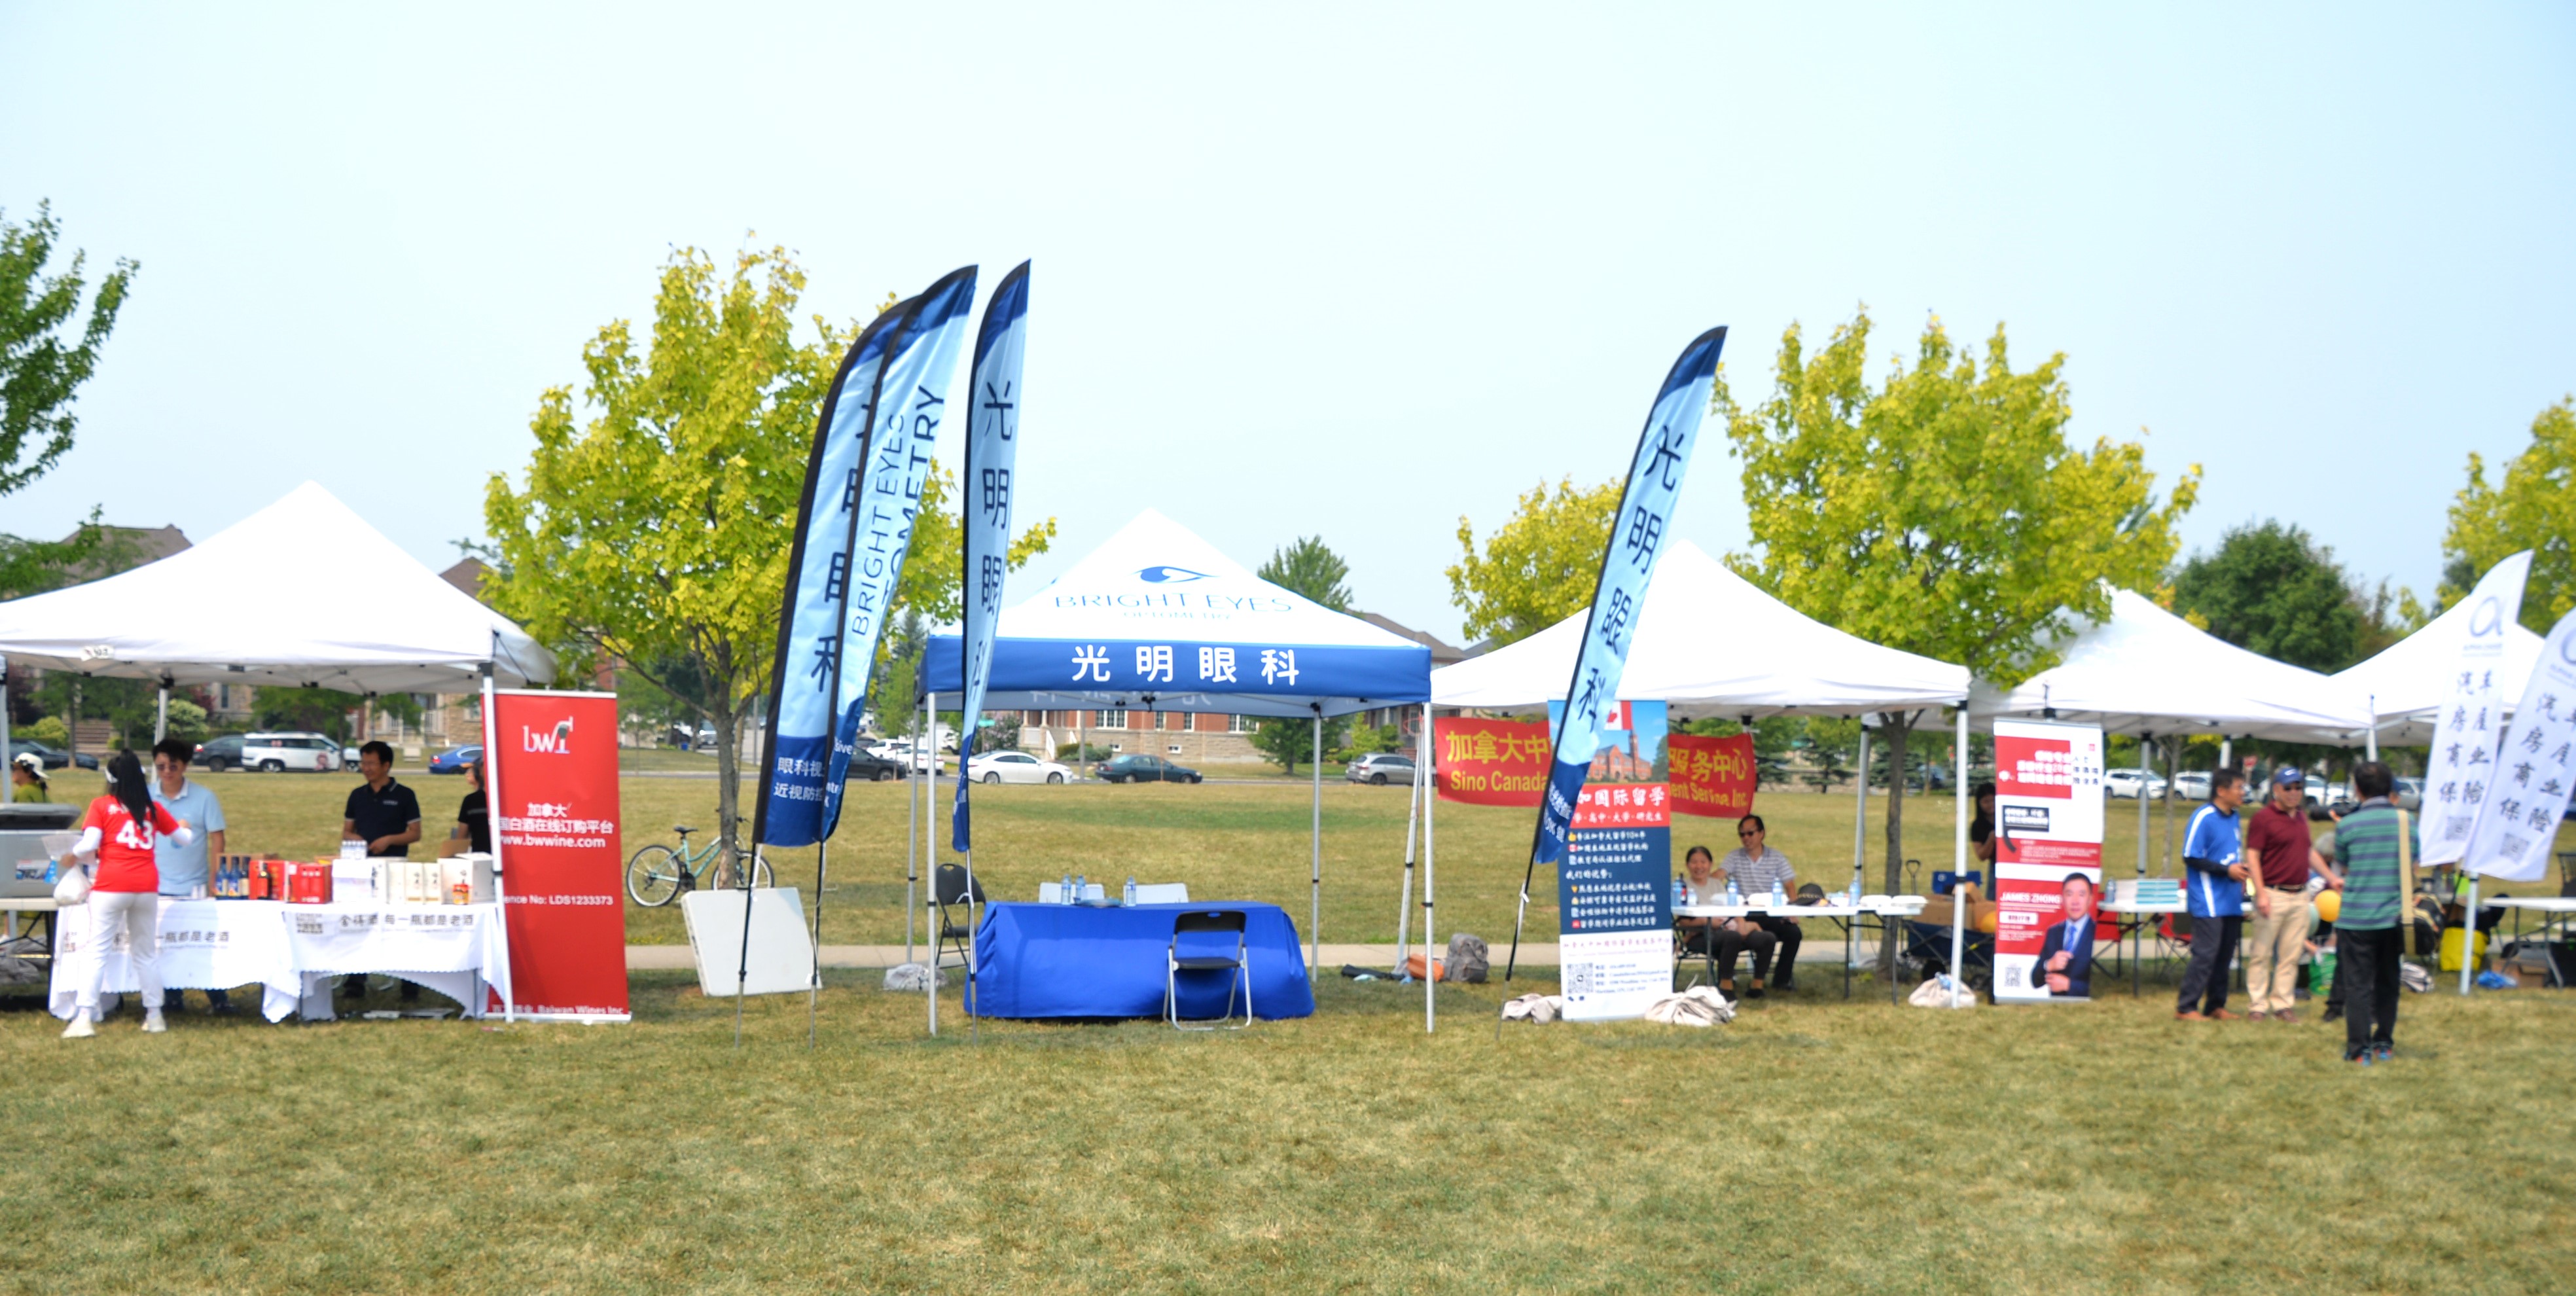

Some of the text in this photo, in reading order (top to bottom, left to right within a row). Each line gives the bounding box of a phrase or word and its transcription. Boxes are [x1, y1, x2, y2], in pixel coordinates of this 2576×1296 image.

[881, 384, 945, 606] TOMETRY
[852, 505, 892, 636] BRIGHT
[1579, 425, 1685, 734] 光明眼科
[1055, 592, 1293, 613] BRIGHT EYES
[1071, 644, 1300, 687] 光明眼科
[777, 756, 825, 778] 眼科视
[1445, 729, 1748, 789] 加拿大中 服务中心
[1450, 769, 1487, 791] Sino
[1491, 770, 1548, 792] Canada
[1732, 788, 1748, 808] Inc.
[499, 818, 615, 835] 国白酒在线订购平台
[527, 802, 567, 818] 加拿大
[116, 819, 154, 850] 43
[1999, 891, 2030, 903] JAMES
